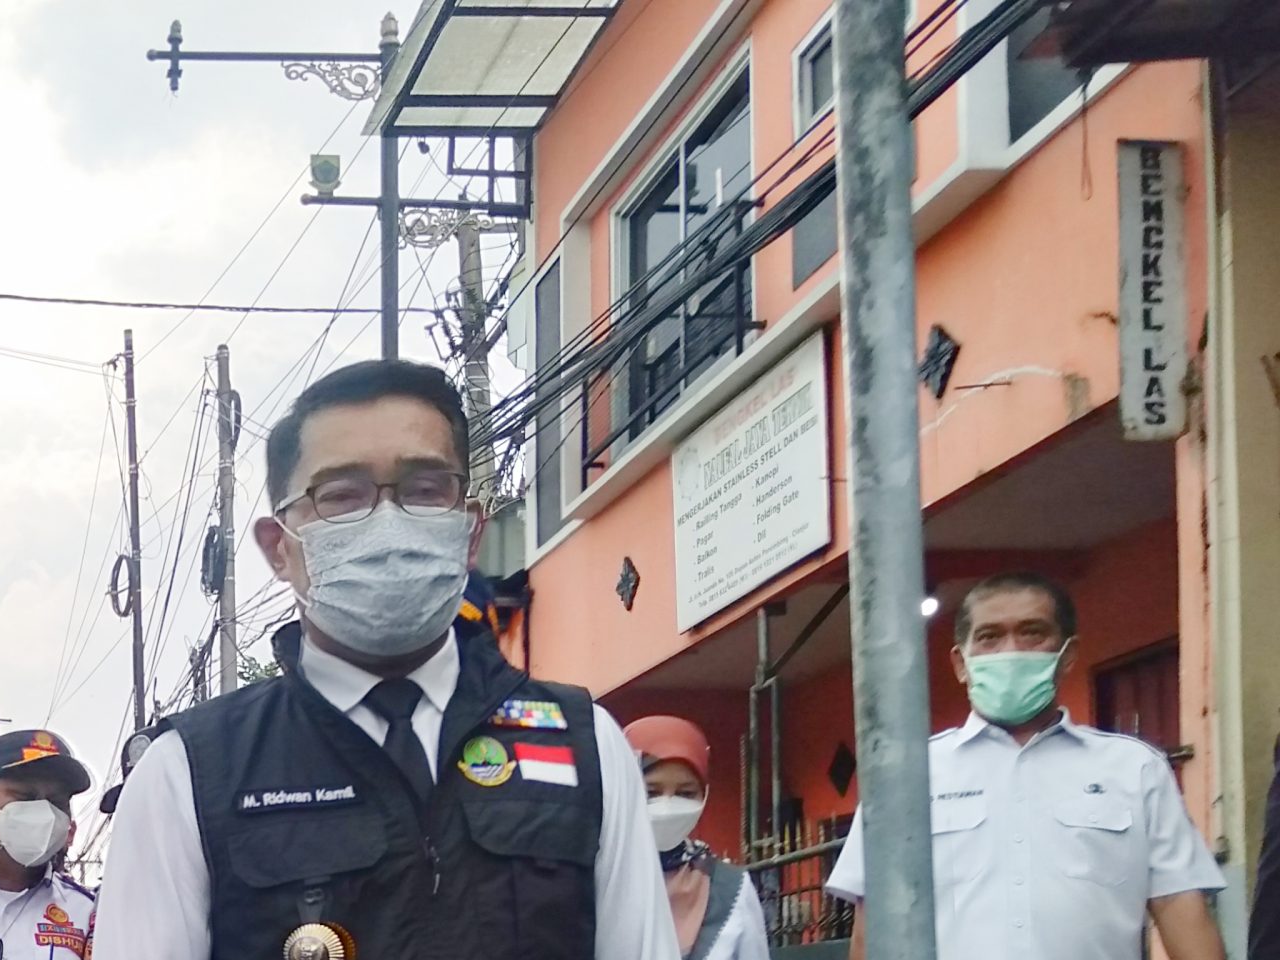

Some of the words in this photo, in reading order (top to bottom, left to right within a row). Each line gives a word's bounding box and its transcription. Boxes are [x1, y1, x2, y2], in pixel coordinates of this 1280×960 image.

[1139, 145, 1163, 332] BENGKEL
[1143, 348, 1166, 426] LAS
[677, 488, 722, 526] MENGERJAKAN
[723, 459, 759, 493] STAINLESS
[760, 443, 782, 465] STELL
[783, 428, 799, 448] DAN
[756, 475, 792, 506] Handerson
[756, 502, 781, 525] Folding
[782, 490, 799, 507] Gate
[696, 530, 714, 548] Pagar
[697, 546, 718, 565] Balkon
[243, 794, 261, 808] M.
[262, 790, 312, 806] Ridwan
